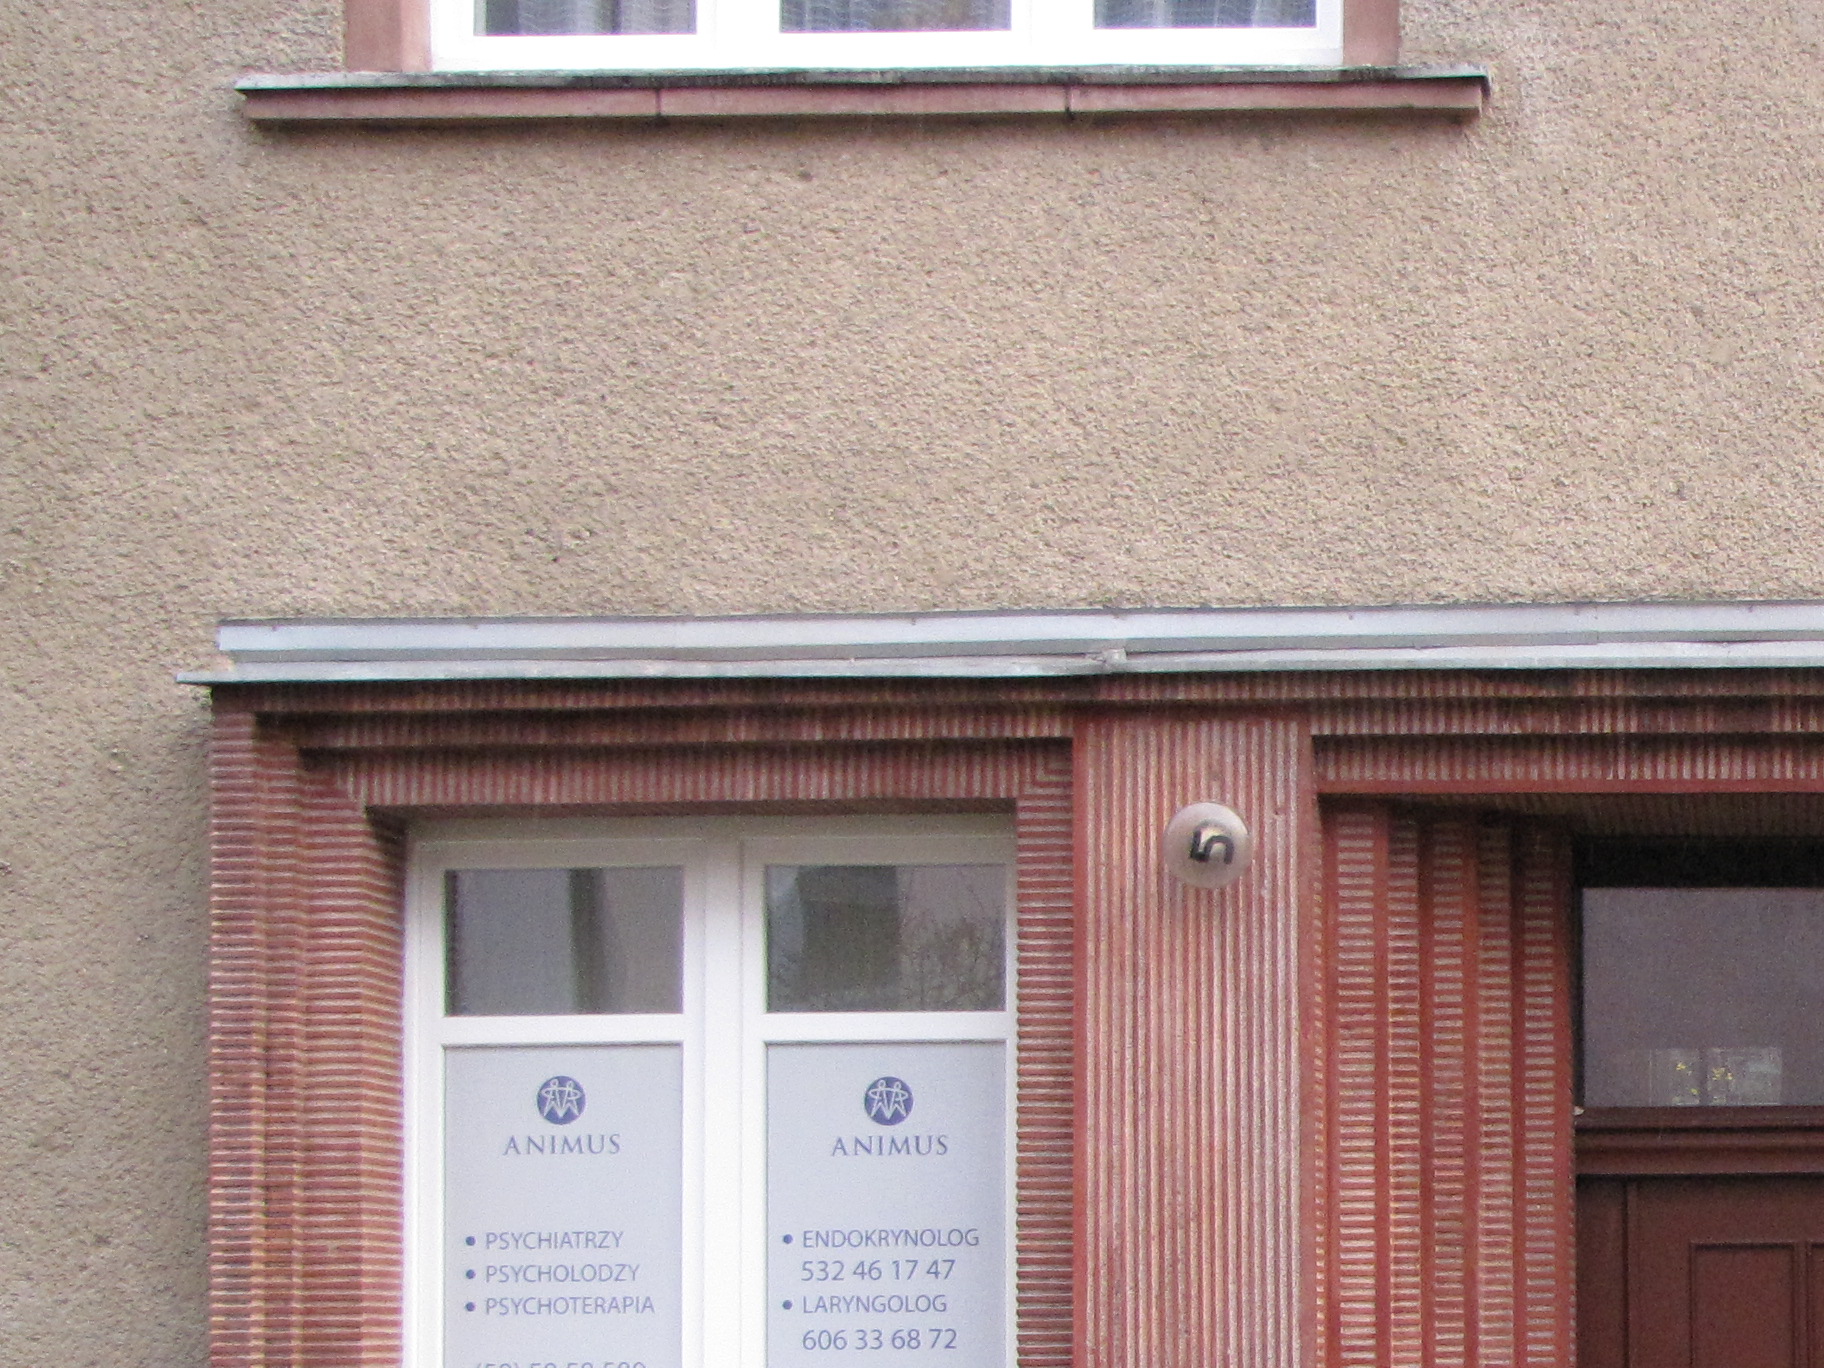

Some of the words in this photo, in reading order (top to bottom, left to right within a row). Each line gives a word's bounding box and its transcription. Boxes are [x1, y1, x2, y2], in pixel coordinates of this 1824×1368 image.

[502, 1133, 621, 1155] ANIMUS
[831, 1134, 949, 1156] ANIMUS
[486, 1231, 624, 1250] PSYCHIATRZY
[803, 1228, 980, 1248] ENDOKRYNOLOG
[486, 1263, 640, 1283] PSYCHOLODZY
[801, 1260, 845, 1281] 532
[853, 1260, 882, 1281] 46
[892, 1259, 918, 1280] 17
[926, 1259, 956, 1280] 47
[486, 1296, 655, 1315] PSYCHOTERAPIA
[803, 1294, 947, 1313] LARYNGOLOG
[802, 1329, 848, 1350] 606
[855, 1329, 883, 1350] 33
[891, 1329, 921, 1349] 68
[929, 1328, 957, 1350] 72
